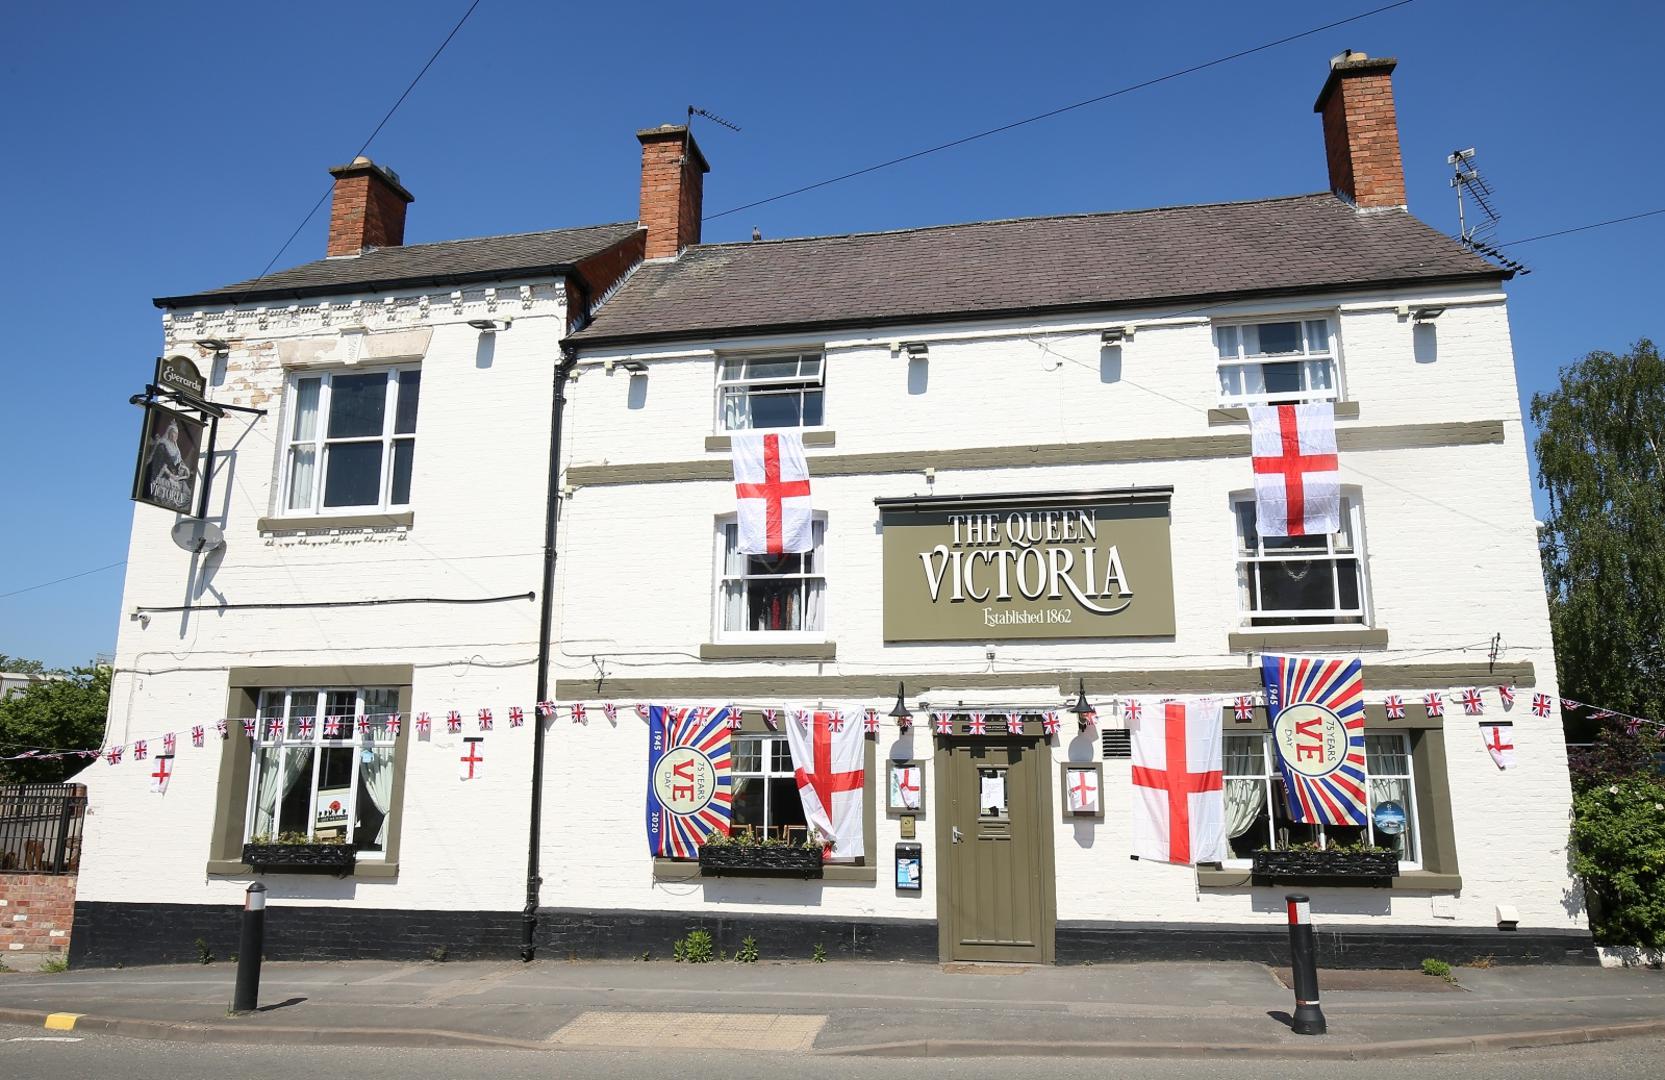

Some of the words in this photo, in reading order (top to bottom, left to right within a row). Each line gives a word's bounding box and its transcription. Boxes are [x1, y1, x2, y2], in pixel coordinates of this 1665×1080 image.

[163, 366, 202, 391] Everards
[948, 513, 1001, 546] THE
[1006, 509, 1097, 548] QUEEN
[919, 544, 1134, 613] VICTORIA
[982, 607, 1044, 627] Established
[1046, 608, 1072, 624] 1862
[1269, 684, 1278, 705] 1945
[653, 730, 662, 751] 1945
[1285, 729, 1293, 746] DAY
[1295, 716, 1324, 763] VE
[1327, 732, 1336, 762] YEARS
[664, 772, 672, 789] DAY
[673, 759, 694, 802] VE
[697, 773, 705, 800] YEARS
[651, 812, 659, 833] 2020
